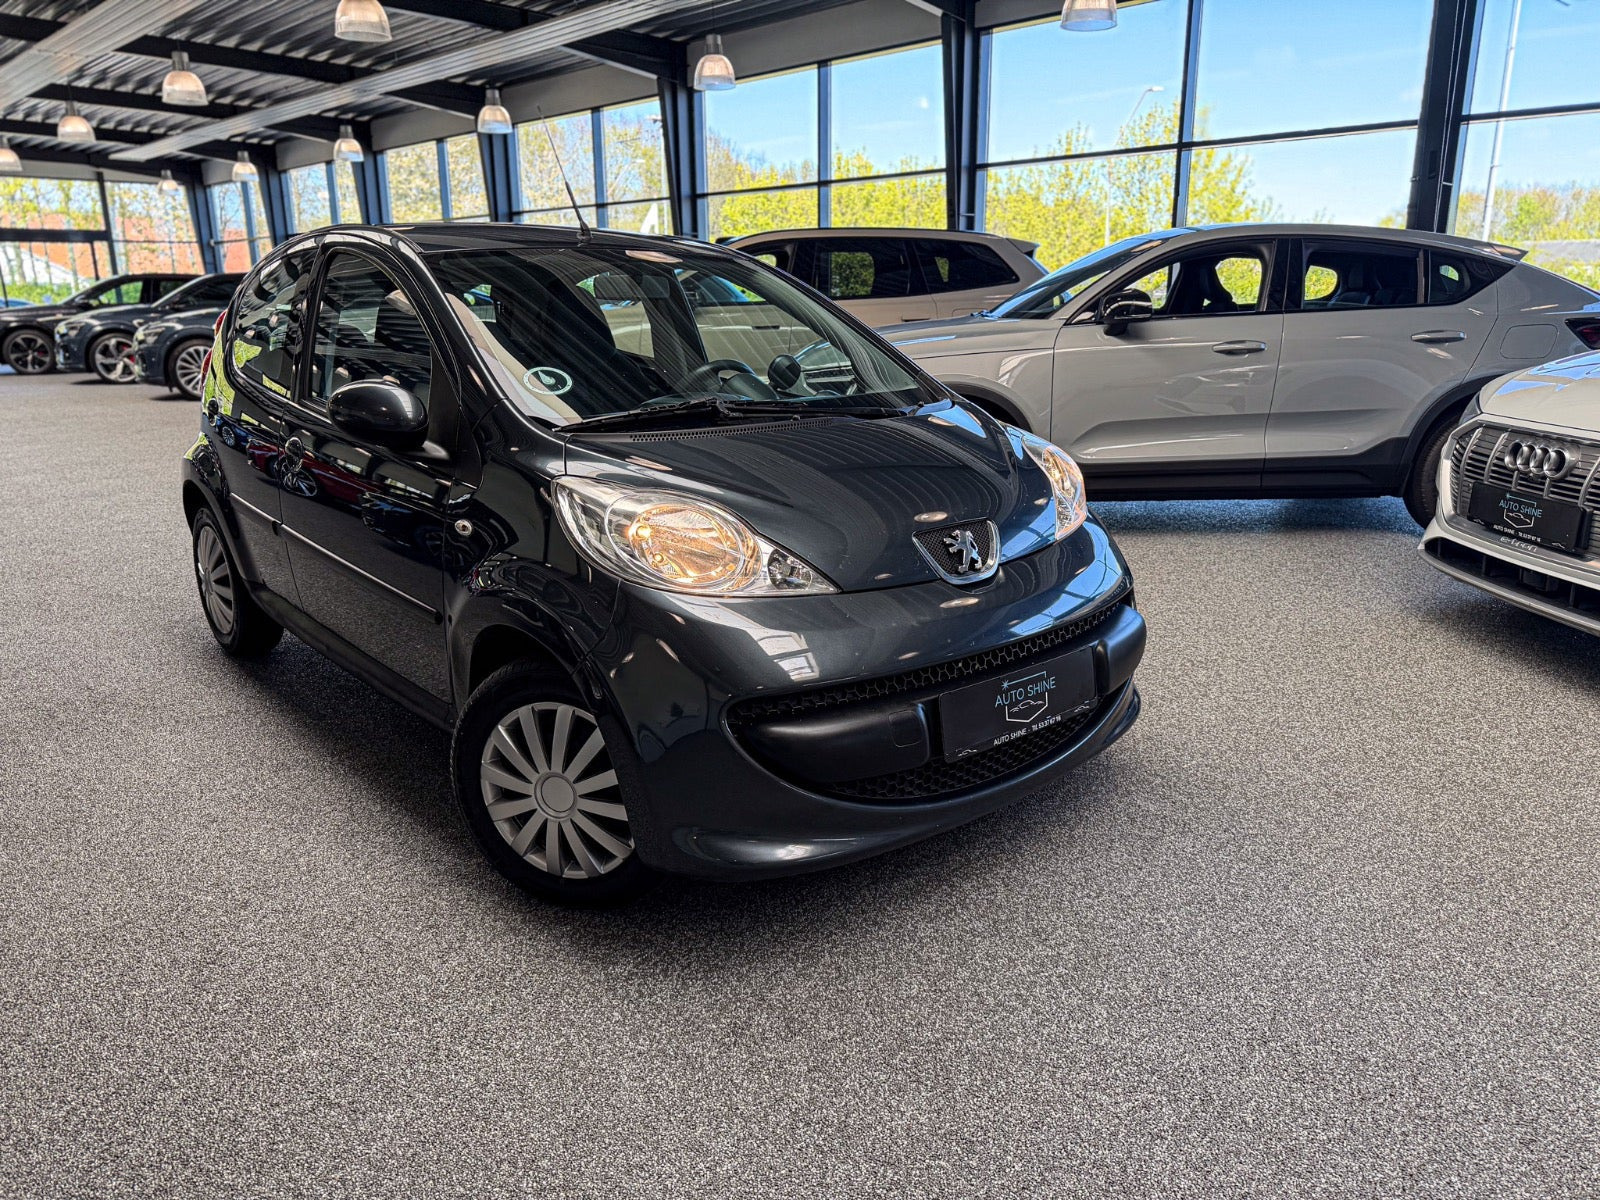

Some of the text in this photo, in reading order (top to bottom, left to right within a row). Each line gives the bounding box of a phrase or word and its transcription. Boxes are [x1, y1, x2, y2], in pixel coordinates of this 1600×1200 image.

[1498, 499, 1543, 518] AUTO SHINE
[994, 676, 1057, 708] AUTO SHINE
[993, 735, 1009, 746] AUTO
[1010, 728, 1027, 739] SHINE
